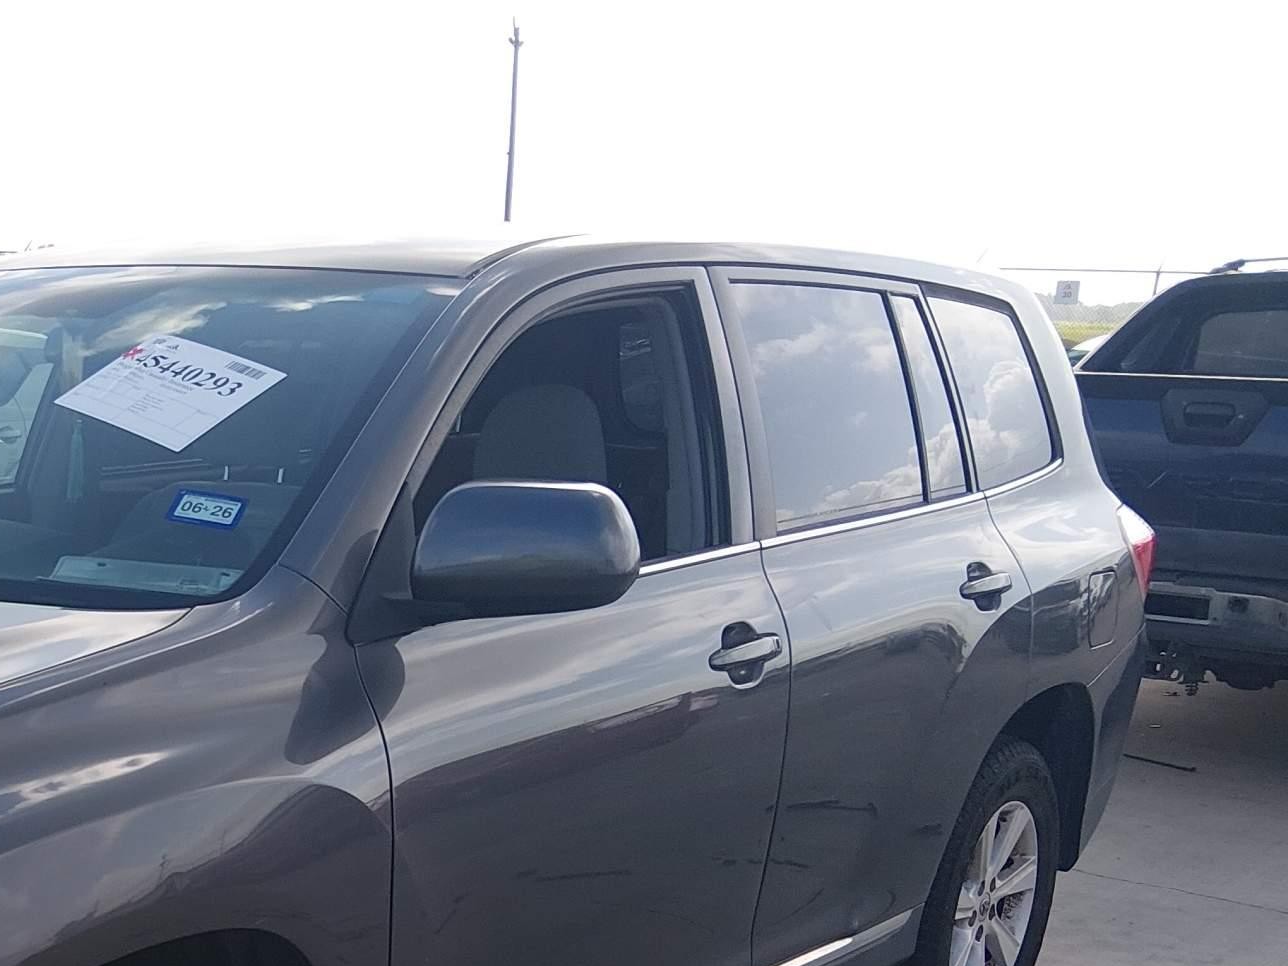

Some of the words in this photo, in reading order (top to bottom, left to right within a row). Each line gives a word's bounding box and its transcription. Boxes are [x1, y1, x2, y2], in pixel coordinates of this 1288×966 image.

[136, 351, 243, 397] 45440293
[180, 500, 204, 514] 06
[209, 504, 235, 519] 26
